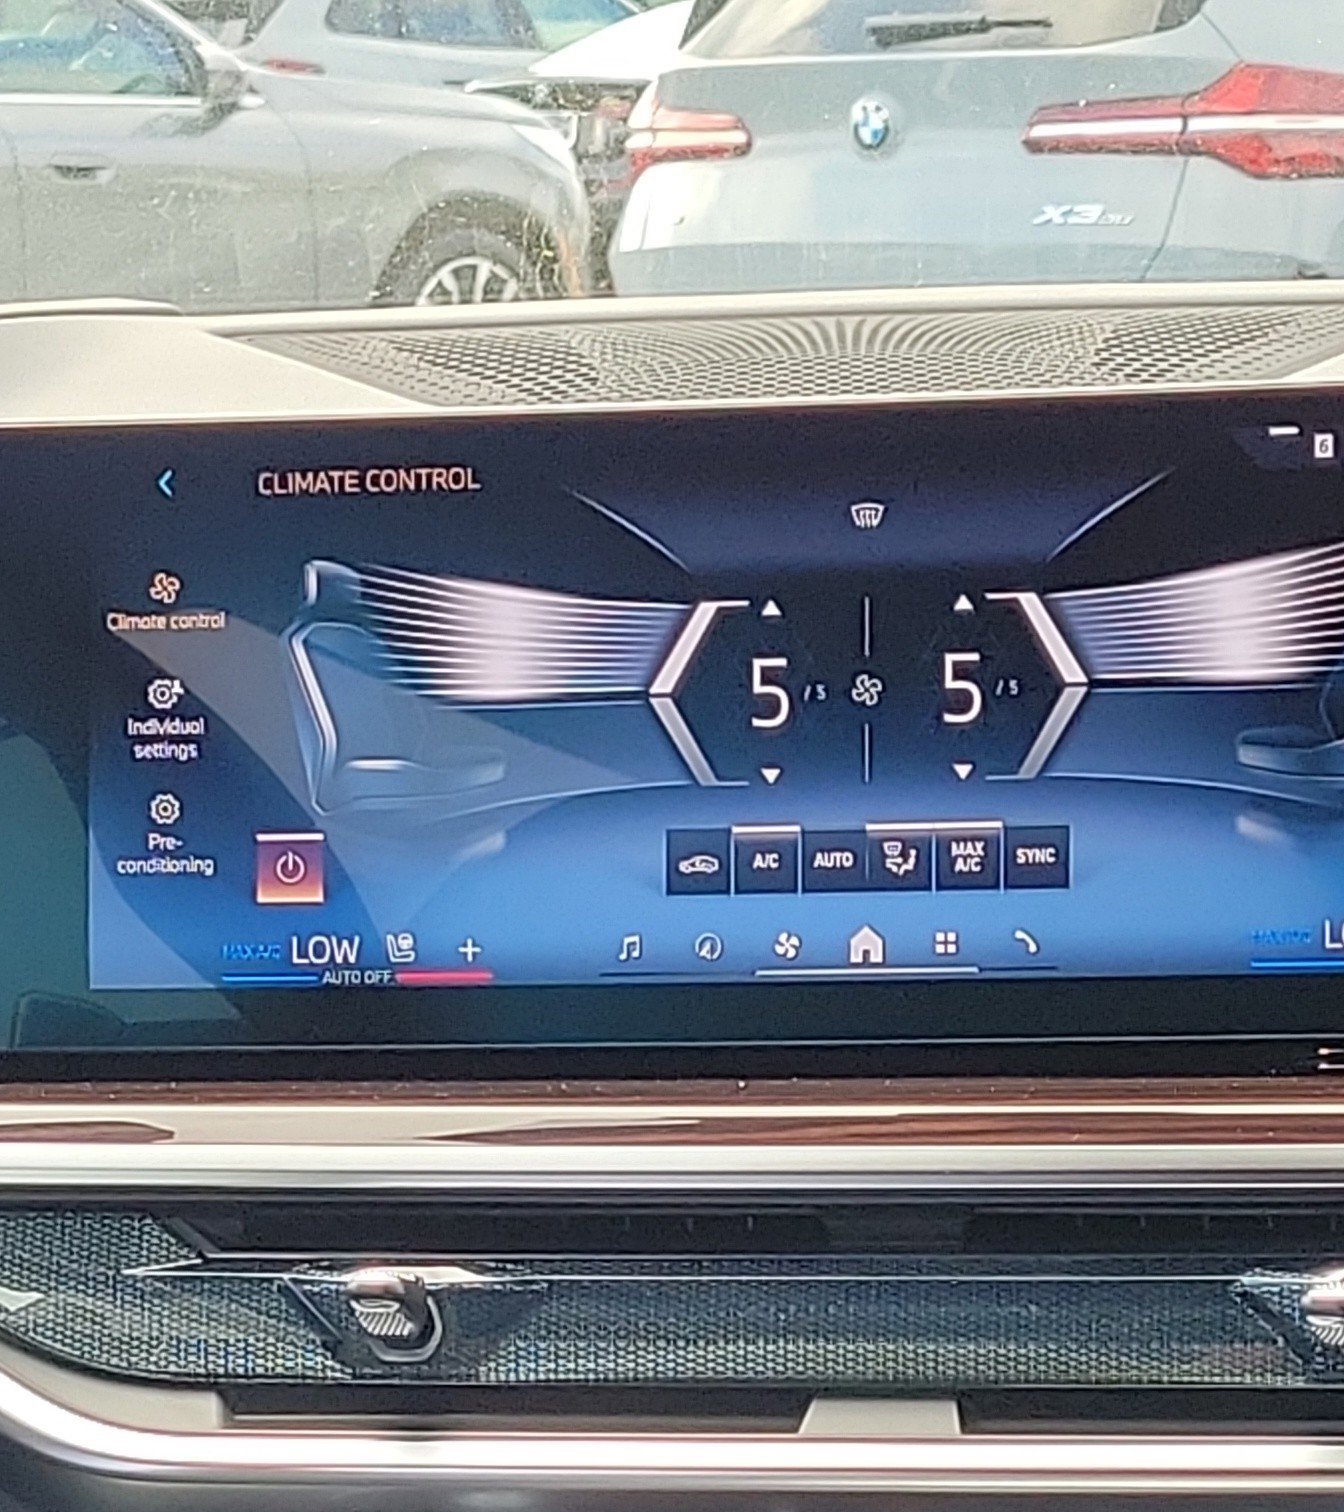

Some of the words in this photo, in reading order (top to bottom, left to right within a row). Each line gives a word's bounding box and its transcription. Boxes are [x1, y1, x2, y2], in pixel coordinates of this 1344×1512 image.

[257, 469, 360, 497] CLIMATE
[365, 466, 483, 495] CONTROL
[106, 611, 168, 632] Climate
[170, 610, 226, 631] control
[751, 656, 790, 729] 5
[942, 651, 982, 724] 5
[127, 717, 205, 738] Individual
[132, 741, 199, 761] settings
[147, 832, 184, 852] Pre-
[951, 840, 986, 858] MAX
[752, 852, 779, 870] A/C
[813, 851, 854, 869] AUTO
[954, 857, 982, 874] A/C
[1015, 847, 1057, 865] SYNC
[116, 856, 215, 878] conditioning
[290, 934, 362, 966] LOW
[322, 968, 362, 986] AUTO
[363, 968, 394, 986] OFF
